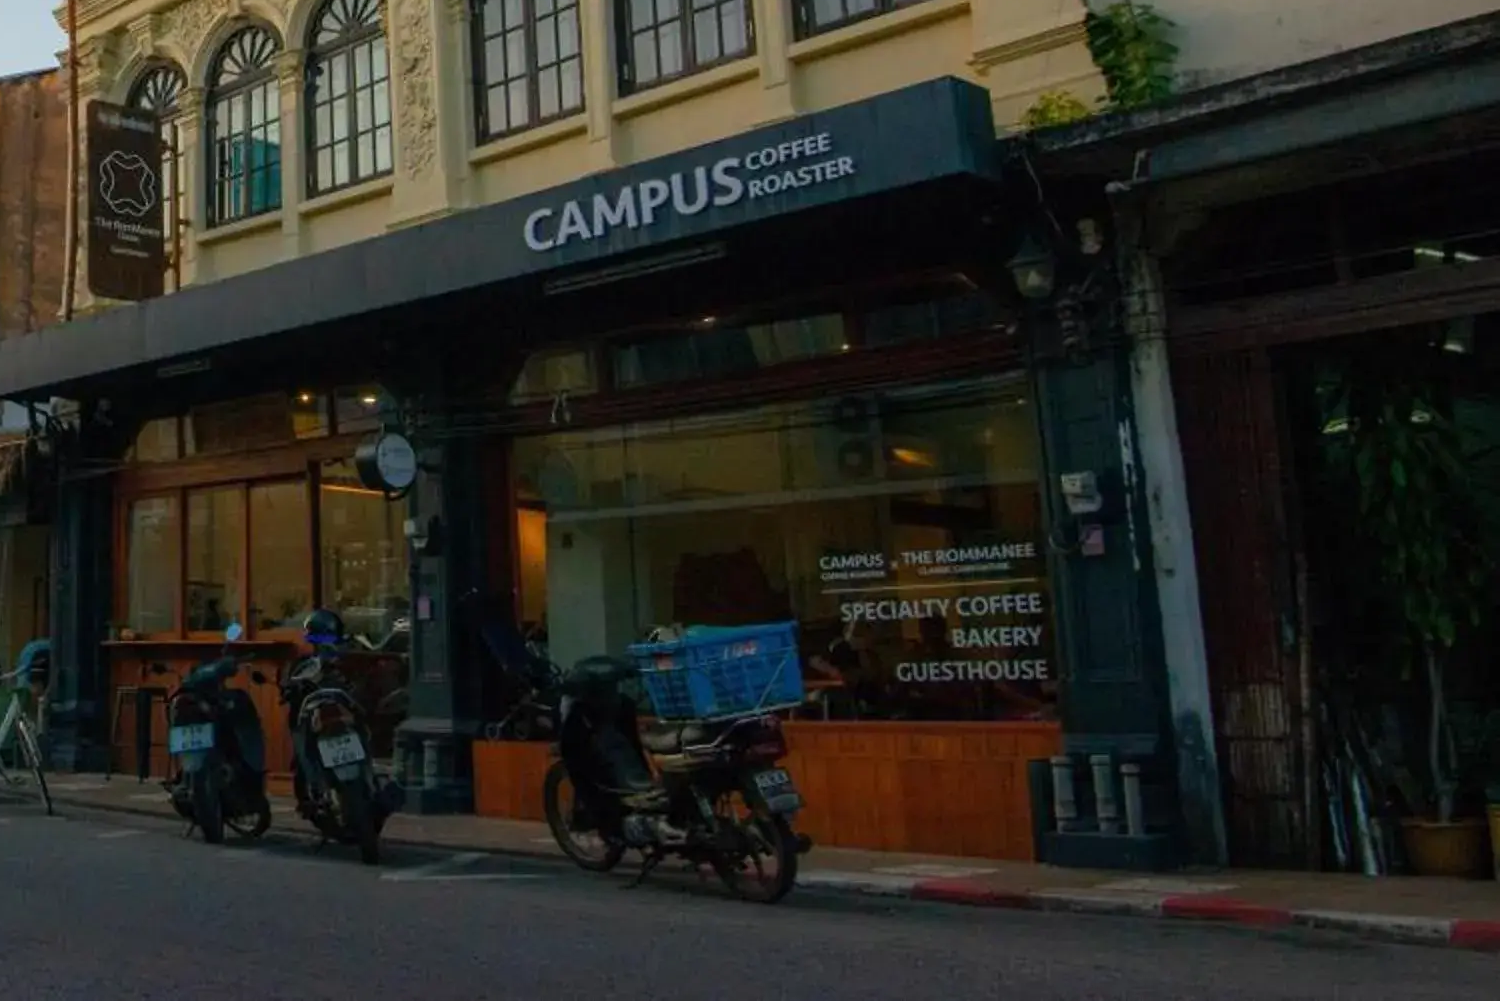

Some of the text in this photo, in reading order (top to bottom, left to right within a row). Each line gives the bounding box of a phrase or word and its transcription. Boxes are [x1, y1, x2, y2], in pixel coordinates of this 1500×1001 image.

[746, 133, 832, 171] COFFEE
[748, 157, 855, 199] ROASTER
[524, 158, 745, 252] CAMPUS
[819, 553, 884, 570] CAMPUS
[901, 550, 934, 565] THE
[935, 542, 1037, 563] ROMMANEE
[840, 593, 1043, 622] SPECIALTY COFFEE
[952, 626, 1042, 648] BAKERY
[896, 660, 1049, 682] GUESTHOUSE
